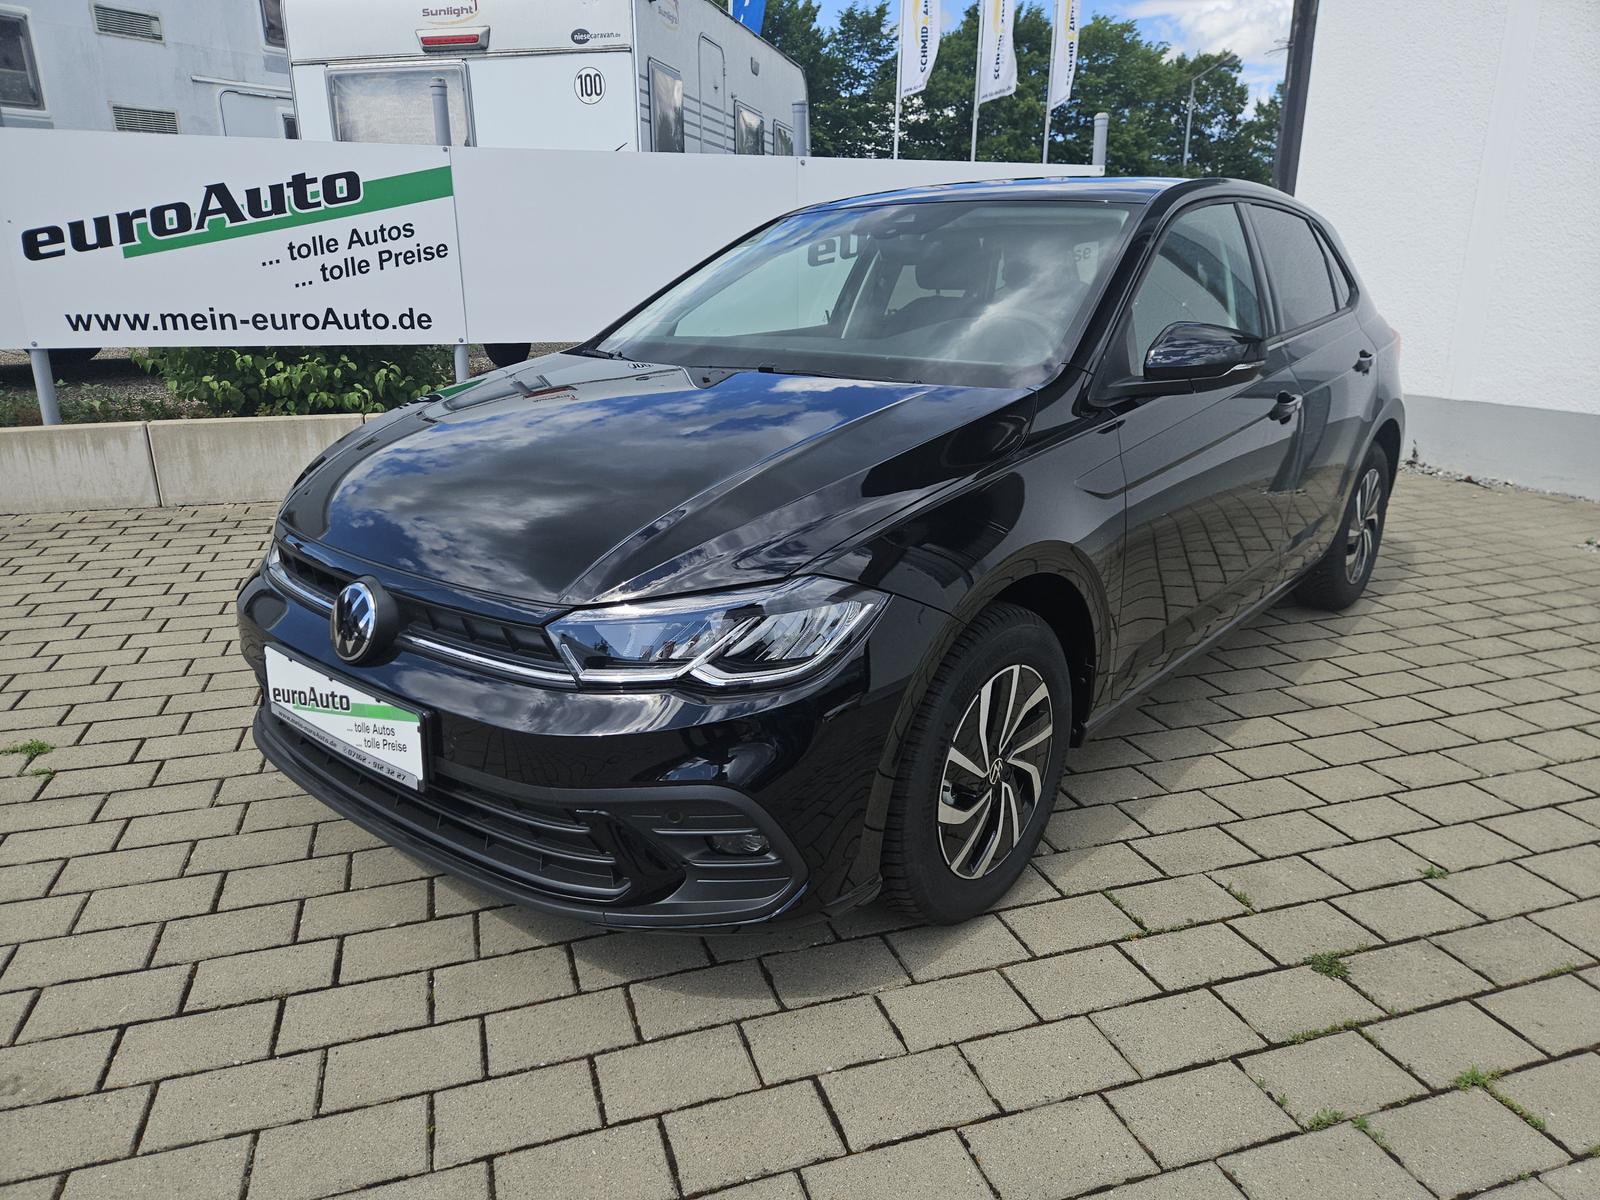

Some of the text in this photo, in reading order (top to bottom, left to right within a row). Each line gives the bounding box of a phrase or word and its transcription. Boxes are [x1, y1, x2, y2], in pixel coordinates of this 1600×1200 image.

[421, 6, 475, 19] Sunlight
[577, 73, 603, 98] 100
[21, 170, 362, 261] euroAuto
[287, 235, 339, 263] tolle
[346, 219, 415, 250] Autos
[320, 254, 371, 283] tolle
[378, 241, 449, 271] Preise
[65, 307, 433, 332] www.mein-euroAuto.de
[272, 686, 351, 711] euroAuto
[354, 722, 370, 735] tolle
[372, 725, 396, 737] Autos
[364, 737, 381, 750] tolle
[382, 738, 408, 753] Preise
